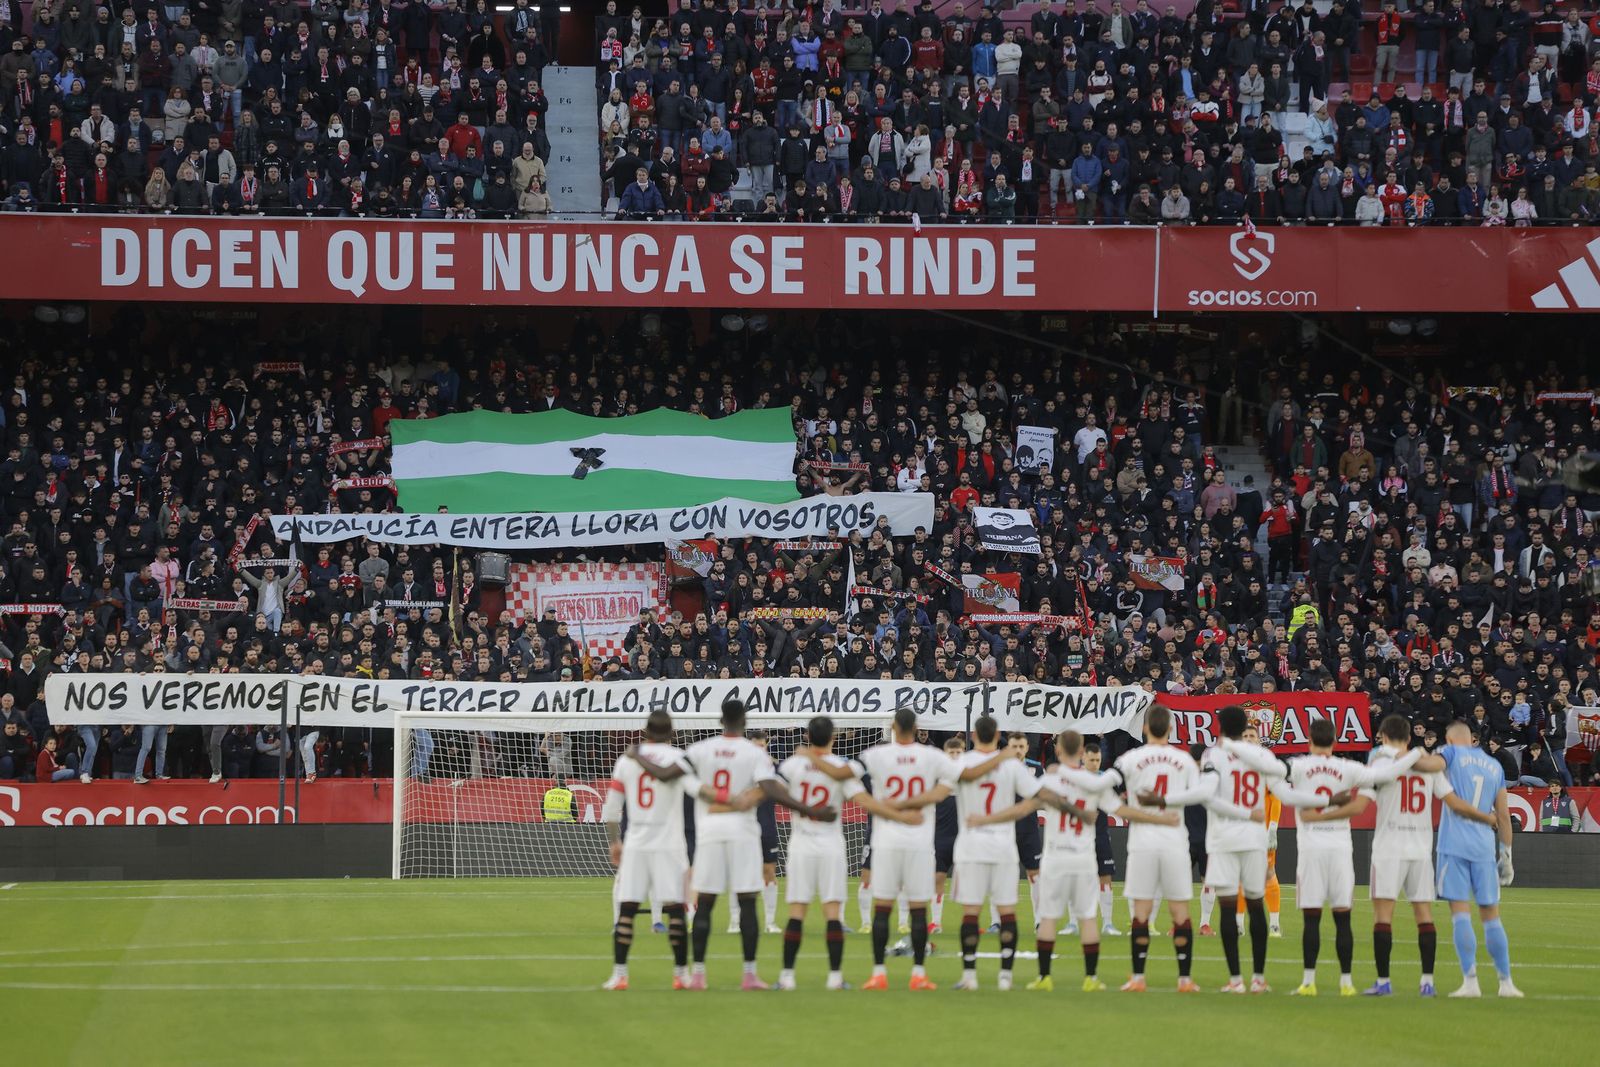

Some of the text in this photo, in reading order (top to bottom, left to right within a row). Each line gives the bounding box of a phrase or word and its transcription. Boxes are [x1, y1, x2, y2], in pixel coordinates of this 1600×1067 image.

[101, 228, 1036, 298] DICEN QUE NUNCA SE RINDE
[1188, 289, 1317, 307] SOCIOS.com
[278, 502, 876, 540] ANDALUCÍA ENTERA LLORA CON VOSOTROS
[216, 602, 236, 610] BIRIS
[64, 681, 128, 711] NOS
[142, 680, 284, 712] VEREMOS
[300, 682, 340, 712] EN
[352, 684, 388, 714] EL
[895, 686, 952, 714] POR
[1168, 706, 1370, 745] TRANA
[637, 770, 655, 809] 6
[713, 769, 730, 794] 9
[886, 776, 925, 800] 20
[980, 783, 997, 816] 7
[1231, 770, 1260, 808] 18
[1397, 775, 1426, 814] 16
[1473, 775, 1484, 810] 1
[800, 782, 830, 820] 12
[1059, 800, 1086, 836] 14
